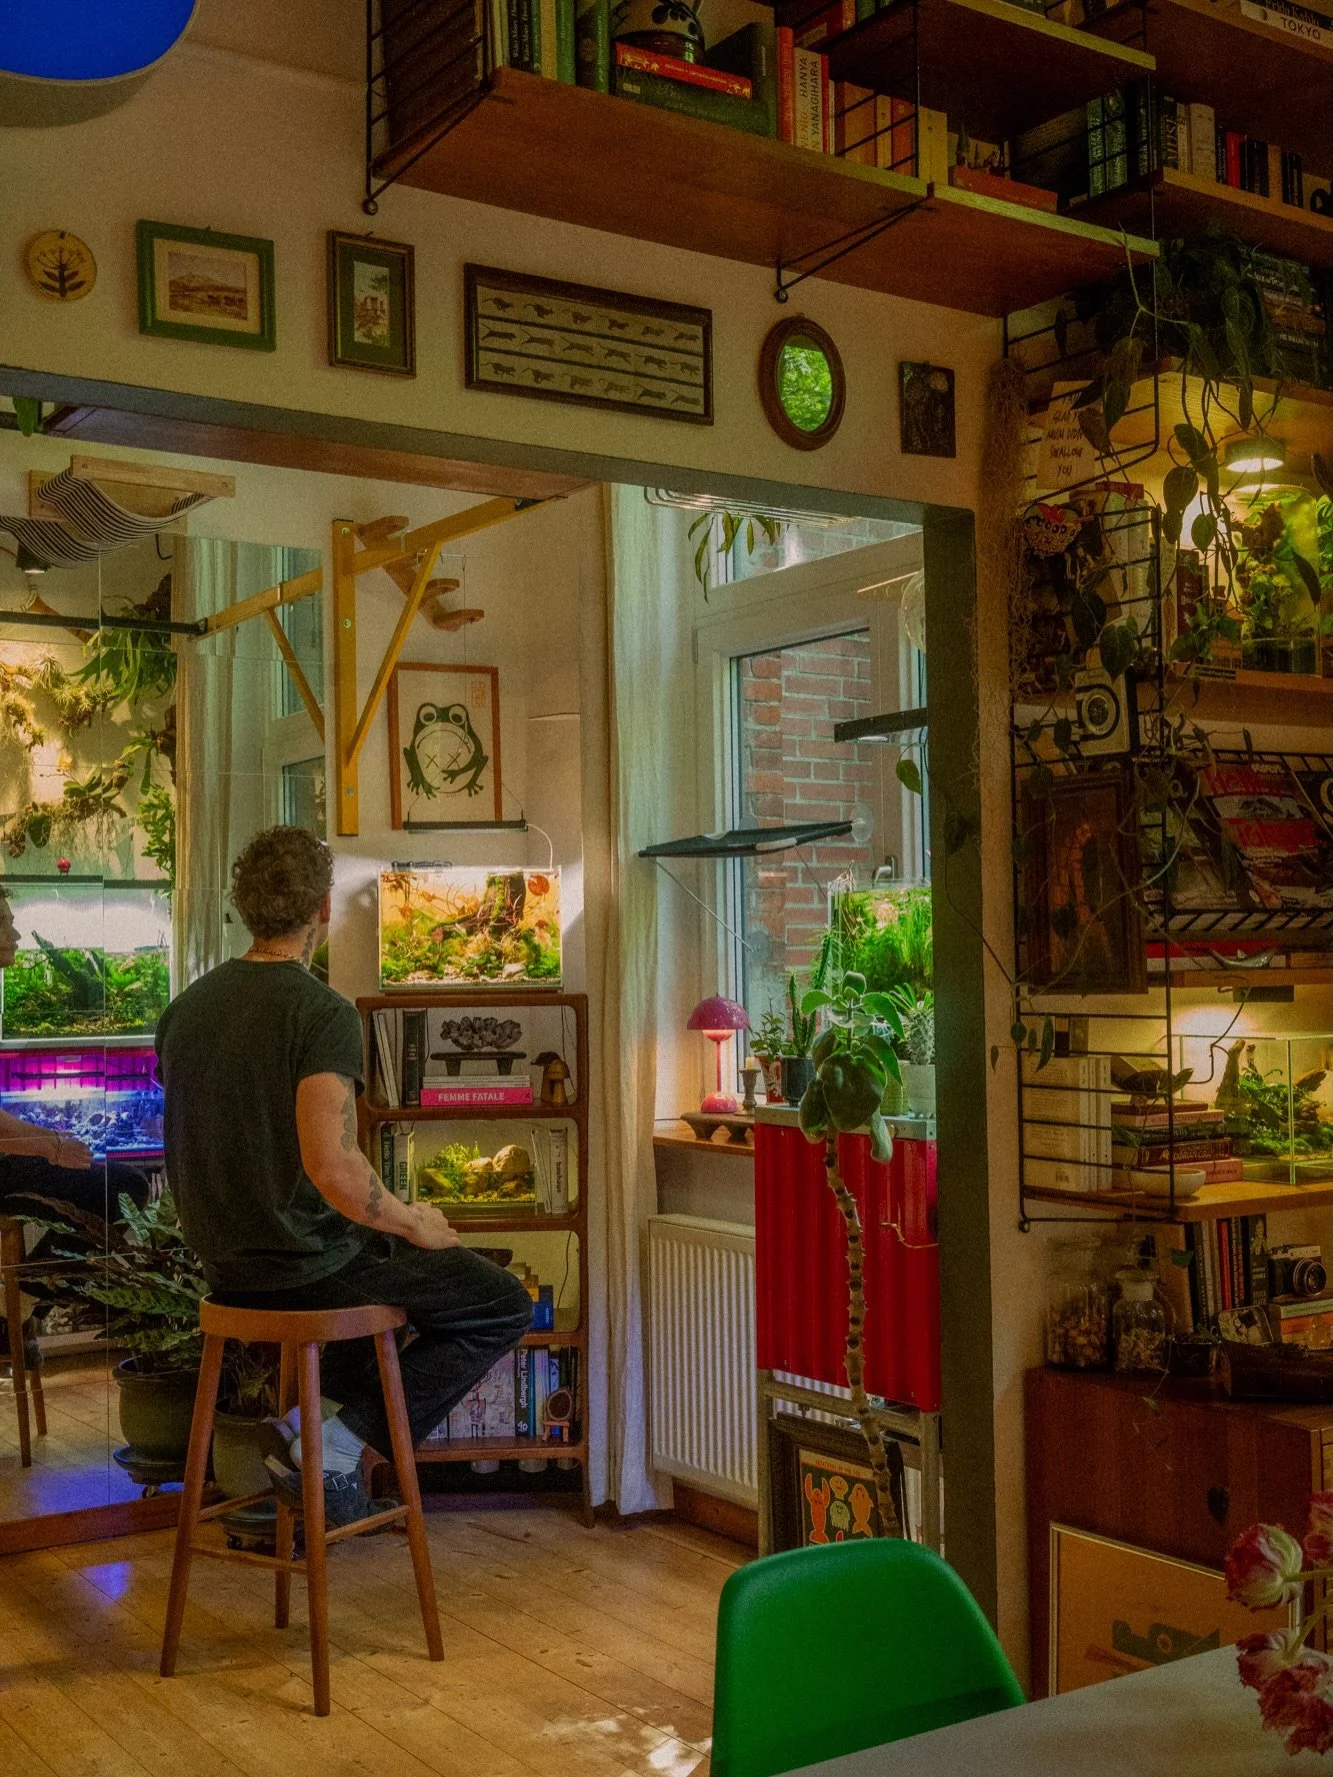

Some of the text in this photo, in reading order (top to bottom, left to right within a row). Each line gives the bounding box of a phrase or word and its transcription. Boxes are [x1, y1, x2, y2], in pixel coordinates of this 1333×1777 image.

[1281, 16, 1321, 40] TOKYO
[799, 57, 808, 98] HANYA
[809, 60, 820, 136] YANAGIHARA
[1057, 463, 1073, 478] YOU
[438, 1092, 505, 1102] FEMME FATALE
[399, 1161, 408, 1190] GREEN
[519, 1348, 528, 1408] Peter Lindbergh
